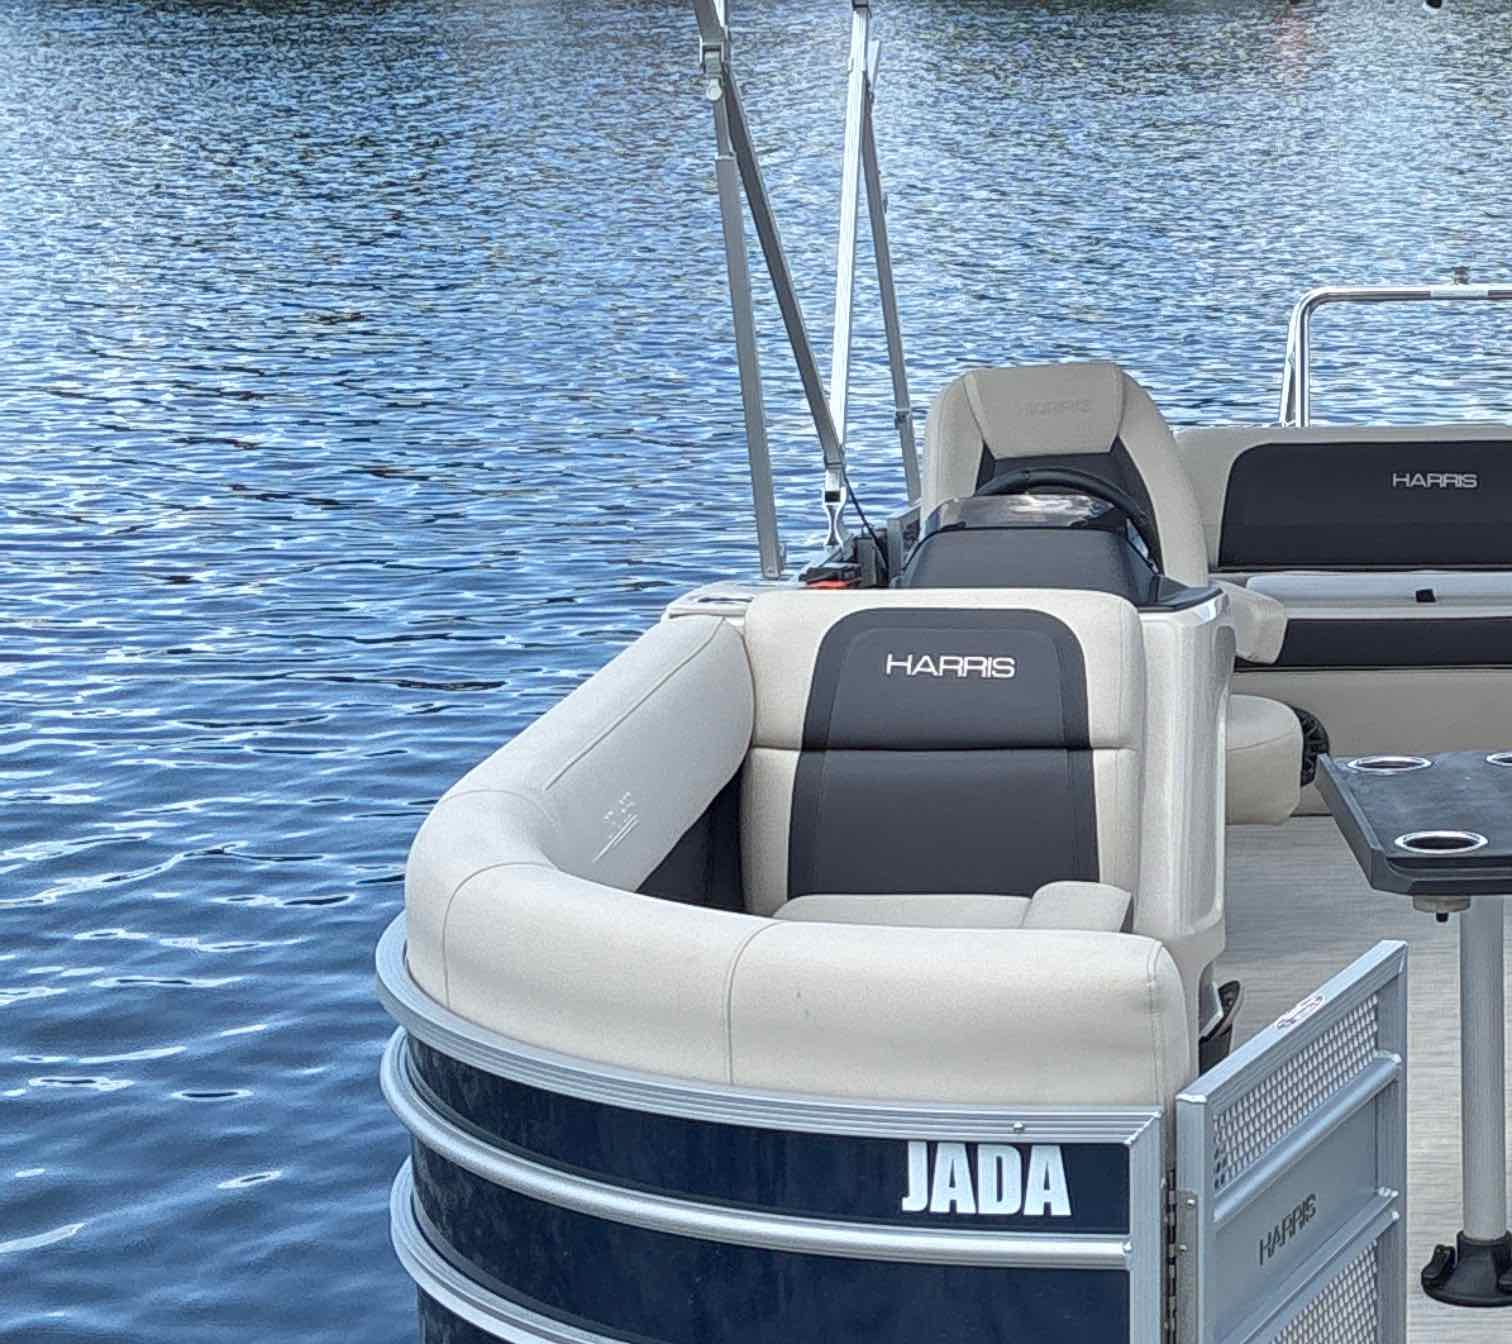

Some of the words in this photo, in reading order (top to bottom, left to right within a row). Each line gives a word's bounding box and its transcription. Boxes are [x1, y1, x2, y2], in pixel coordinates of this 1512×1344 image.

[1392, 472, 1478, 488] HARRIS
[886, 653, 1016, 678] HARRIS
[901, 1140, 1072, 1217] JADA
[1259, 1193, 1317, 1266] HARRIS
